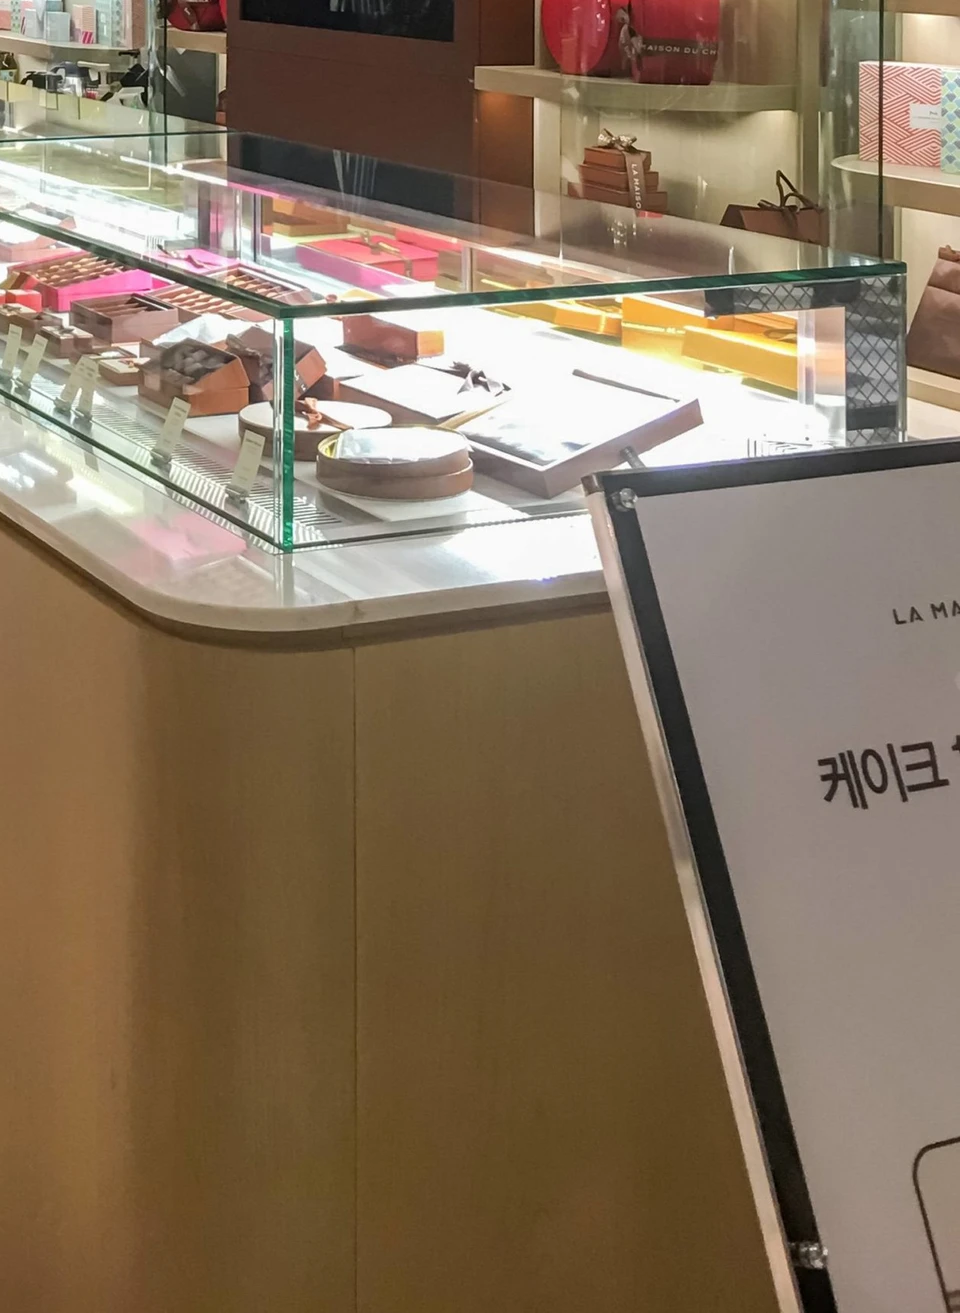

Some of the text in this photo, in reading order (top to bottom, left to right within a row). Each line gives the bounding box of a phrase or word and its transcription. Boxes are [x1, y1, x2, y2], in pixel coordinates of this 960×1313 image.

[683, 47, 699, 55] DU
[631, 163, 642, 209] LA MAISO
[892, 606, 924, 625] LA
[817, 741, 950, 810] 케이크
